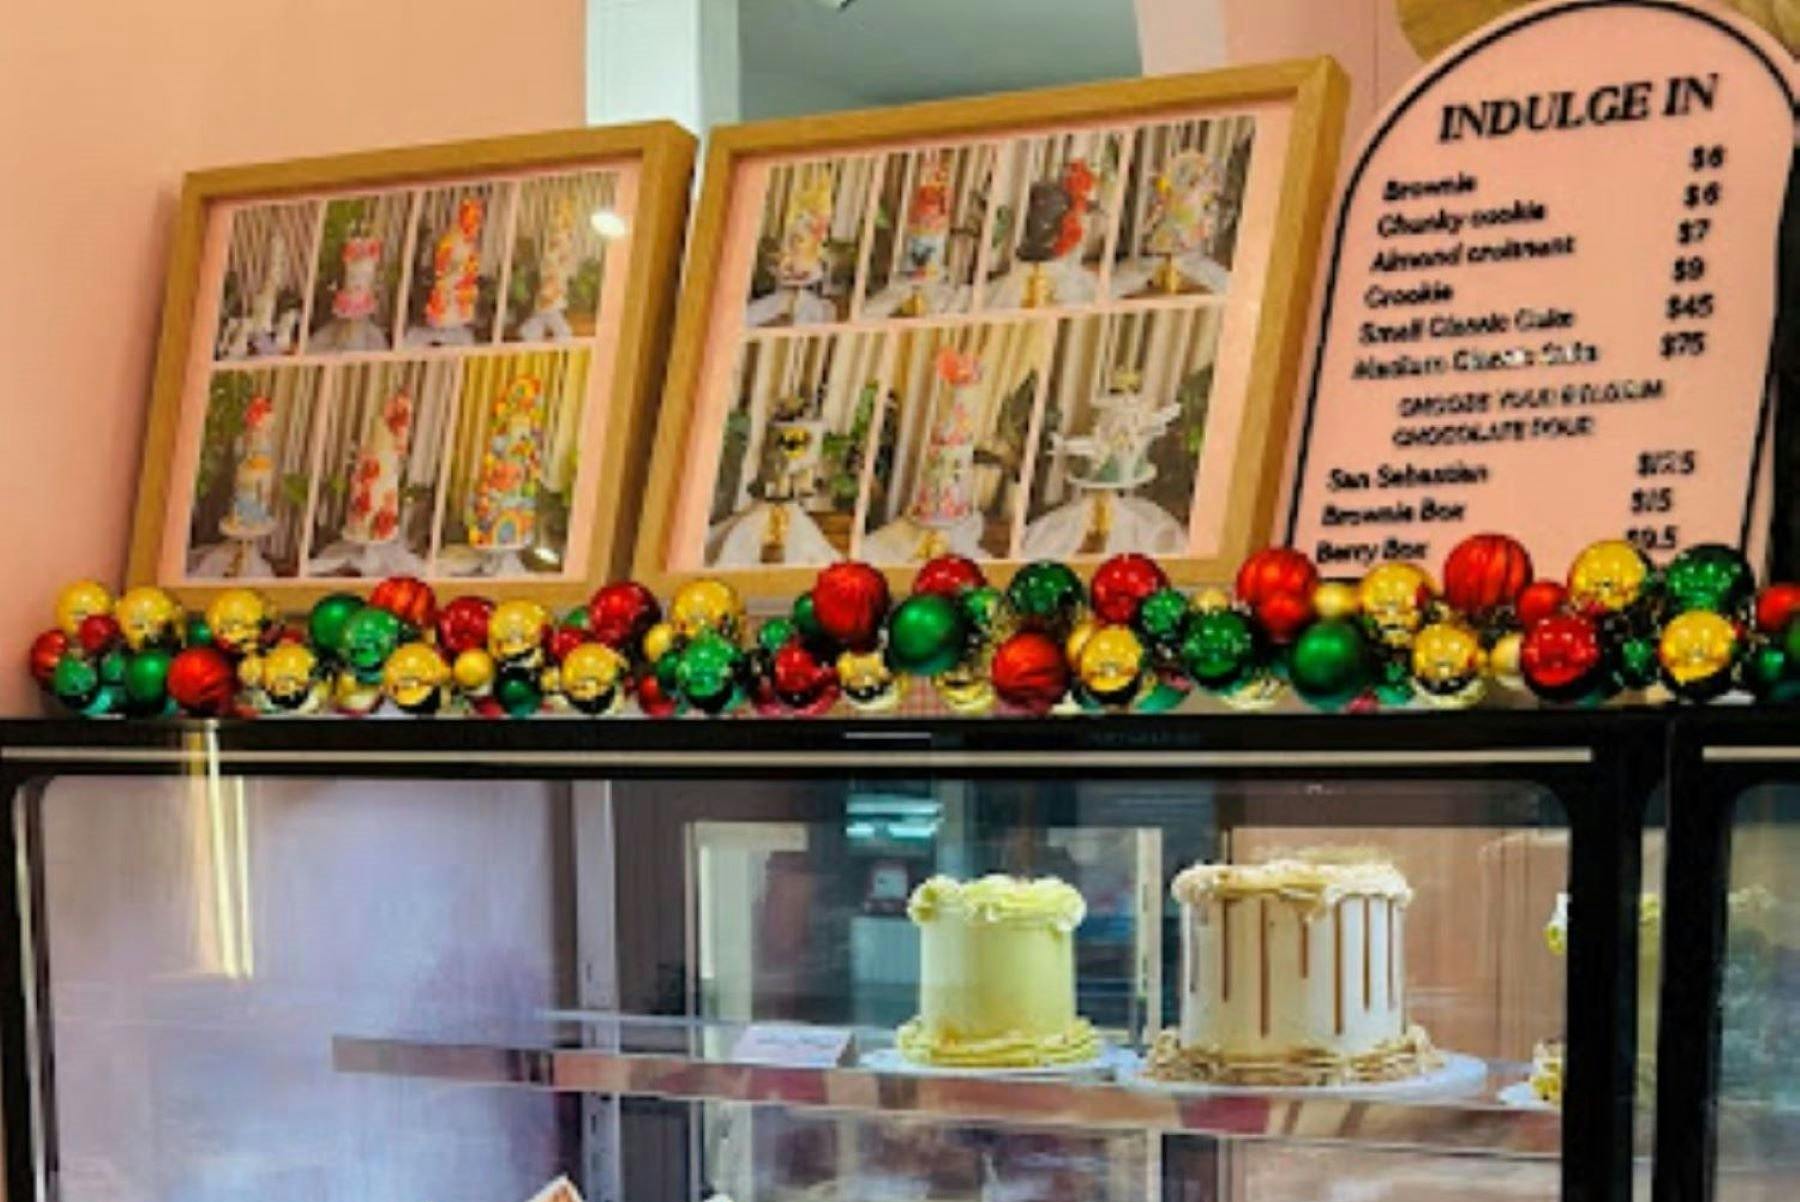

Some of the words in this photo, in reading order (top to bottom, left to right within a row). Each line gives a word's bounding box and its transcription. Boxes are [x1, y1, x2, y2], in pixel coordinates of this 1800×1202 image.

[1438, 81, 1653, 143] INDULGE
[1661, 72, 1719, 117] IN
[1383, 172, 1477, 200] Brownie
[1471, 200, 1546, 227] cookie
[1370, 243, 1463, 272] Almond
[1677, 217, 1711, 245] $7
[1358, 316, 1426, 345] Small
[1665, 293, 1714, 321] $45
[1453, 348, 1535, 372] Clac
[1660, 331, 1706, 360] $75
[1326, 467, 1371, 493] San
[1320, 501, 1413, 527] Brownie
[1420, 498, 1465, 522] Box
[1316, 540, 1379, 566] Berry
[1382, 537, 1428, 561] Box
